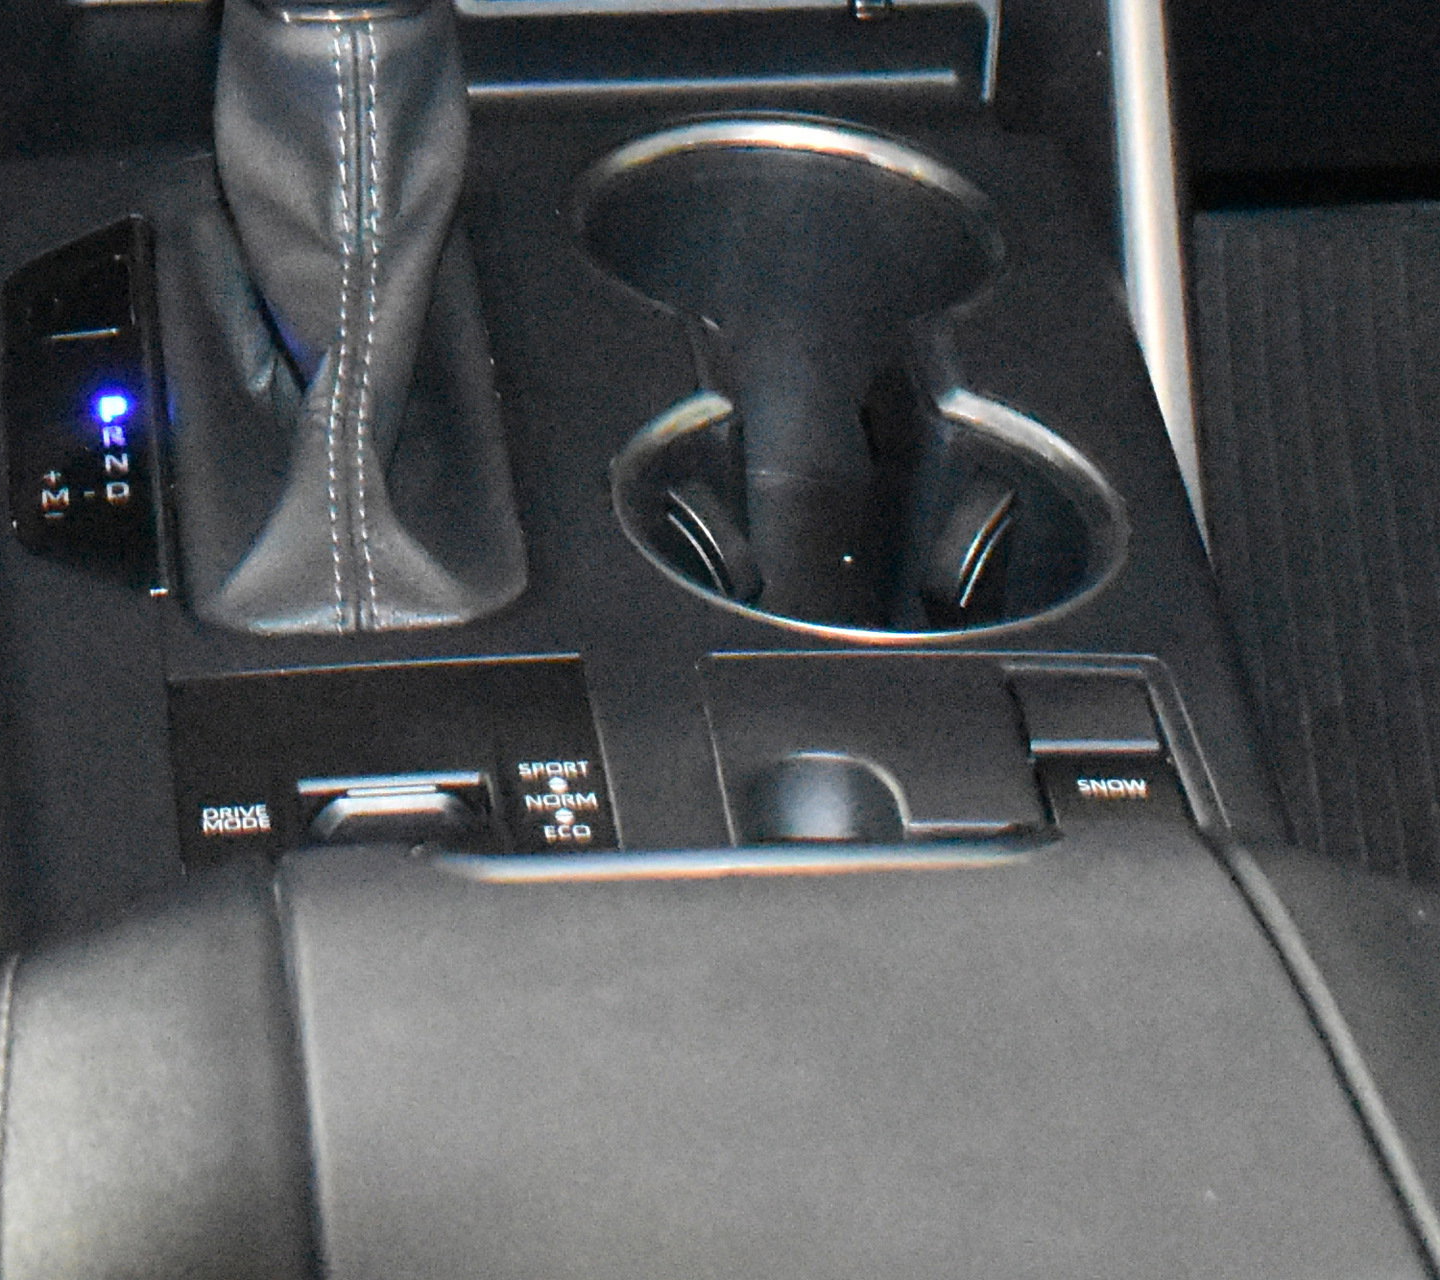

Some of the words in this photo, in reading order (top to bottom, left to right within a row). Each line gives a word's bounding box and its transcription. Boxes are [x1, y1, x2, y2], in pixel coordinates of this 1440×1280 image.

[99, 396, 127, 423] P
[103, 426, 127, 448] R
[105, 453, 129, 474] N
[42, 488, 69, 509] M
[106, 481, 129, 502] D
[518, 761, 590, 778] SPORT
[1077, 778, 1148, 795] SNOW
[525, 792, 597, 810] NORM
[202, 804, 267, 820] DRIVE
[202, 817, 272, 833] MODE
[544, 825, 592, 841] ECO
